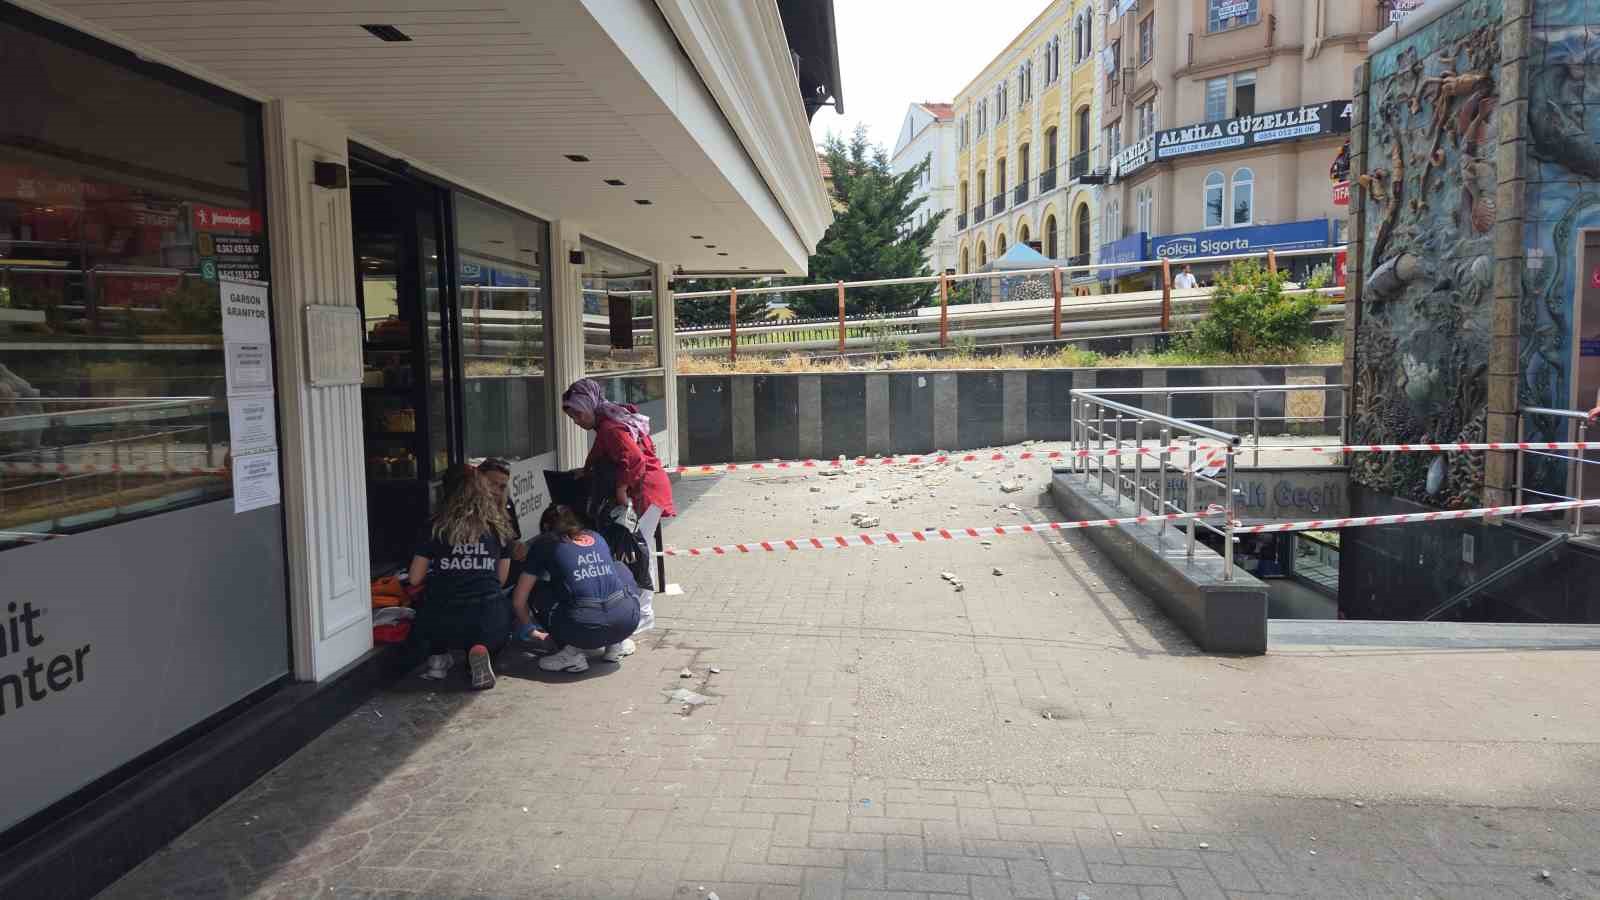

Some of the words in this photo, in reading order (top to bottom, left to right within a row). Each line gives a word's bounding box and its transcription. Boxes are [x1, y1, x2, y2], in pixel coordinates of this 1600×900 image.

[1159, 126, 1222, 147] ALMİLA
[1226, 106, 1320, 135] GÜZELLİK
[1200, 238, 1249, 255] Sigorta
[230, 293, 261, 306] GARSON
[512, 470, 534, 497] Simit
[440, 555, 496, 571] SAĞLIK
[577, 551, 604, 567] ACİL
[574, 564, 613, 581] SAĞLIK
